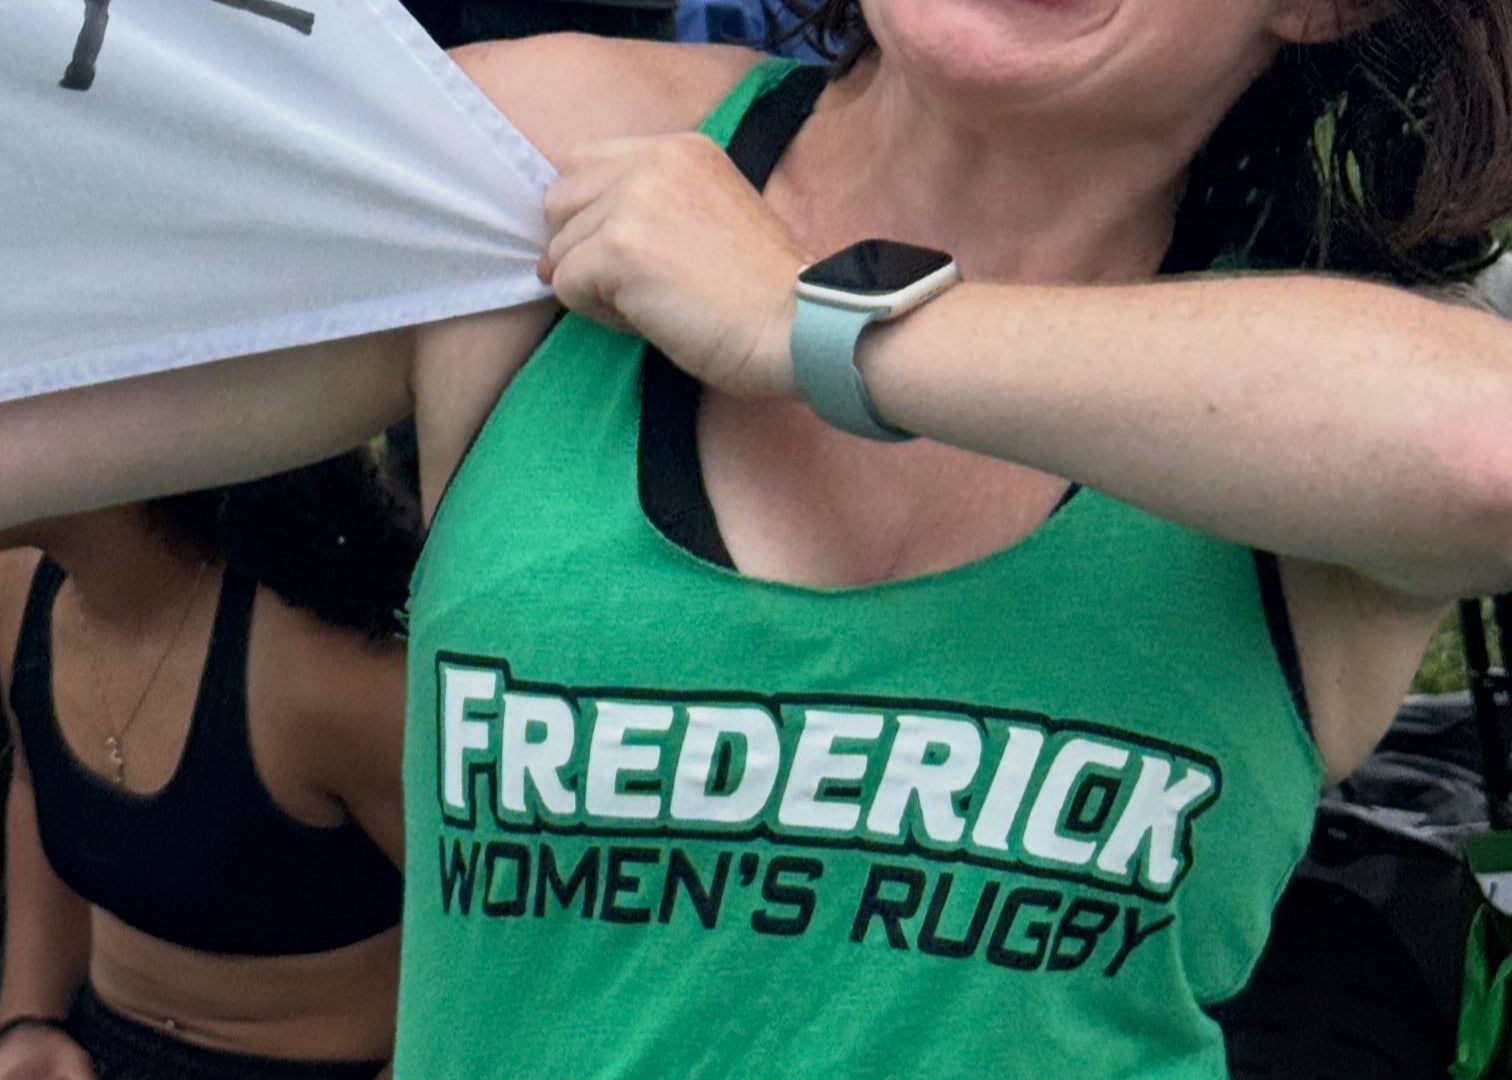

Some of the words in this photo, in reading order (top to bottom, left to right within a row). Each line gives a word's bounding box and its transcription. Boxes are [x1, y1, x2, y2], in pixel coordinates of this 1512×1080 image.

[439, 663, 1214, 887] FREDERICK
[438, 832, 824, 936] WOMEN'S
[849, 861, 1176, 978] RUGBY
